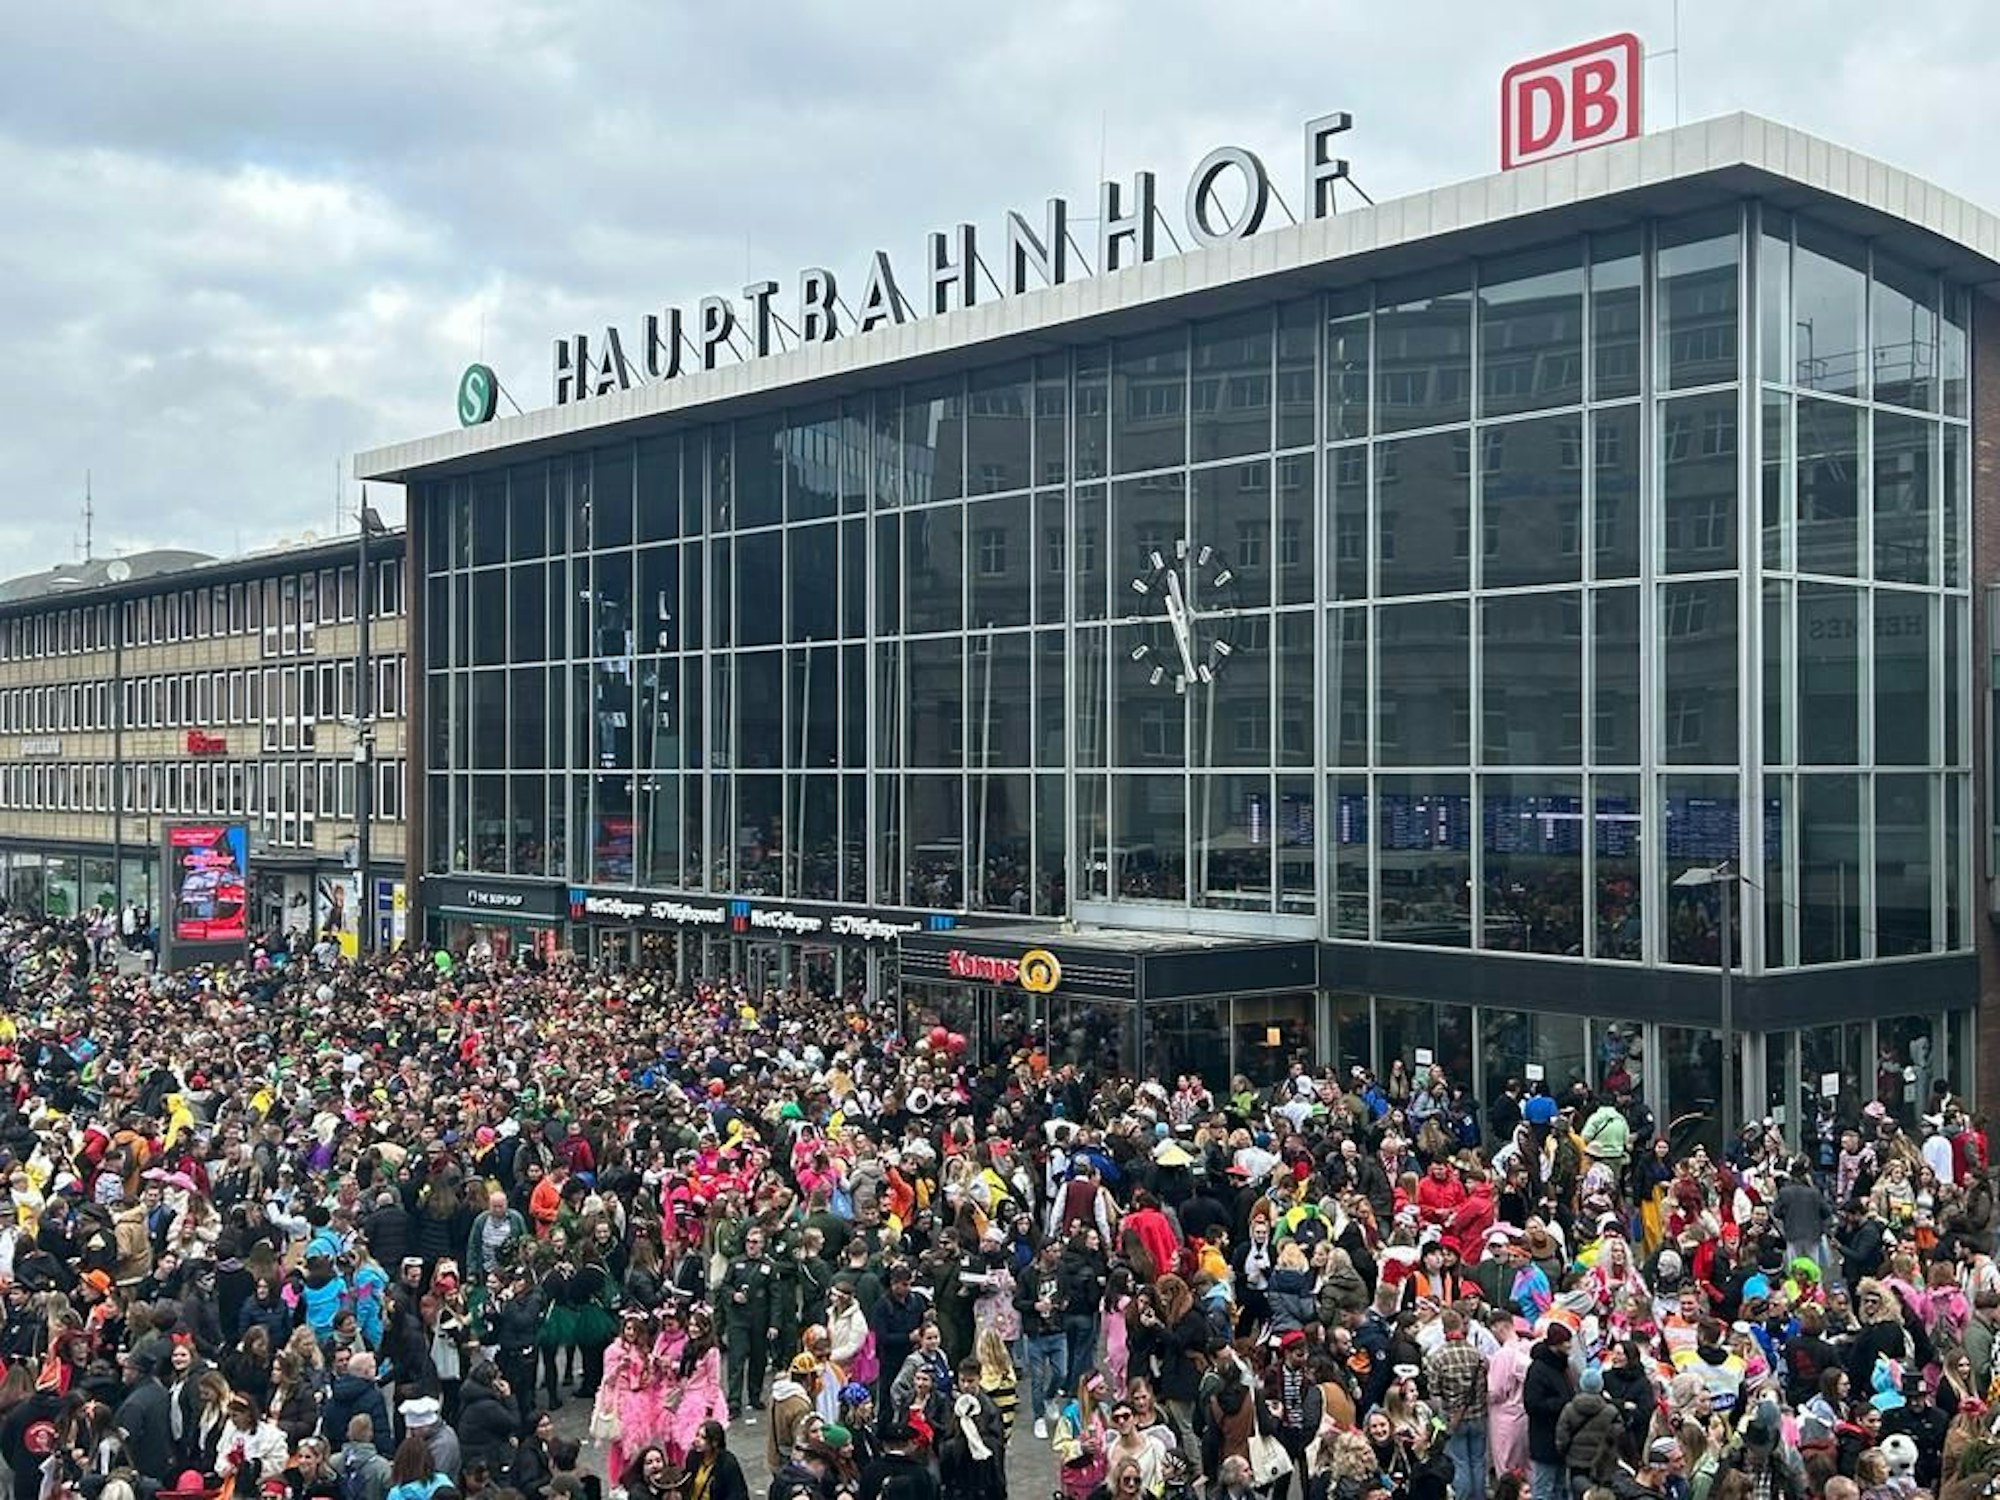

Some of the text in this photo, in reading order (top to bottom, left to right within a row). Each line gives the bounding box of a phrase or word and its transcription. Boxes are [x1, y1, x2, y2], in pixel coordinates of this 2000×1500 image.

[1519, 59, 1618, 156] DB
[553, 111, 1351, 406] HAUPTBAHNHOF
[462, 372, 483, 422] S
[751, 909, 822, 934] NetCologne
[948, 949, 1020, 986] Kamps
